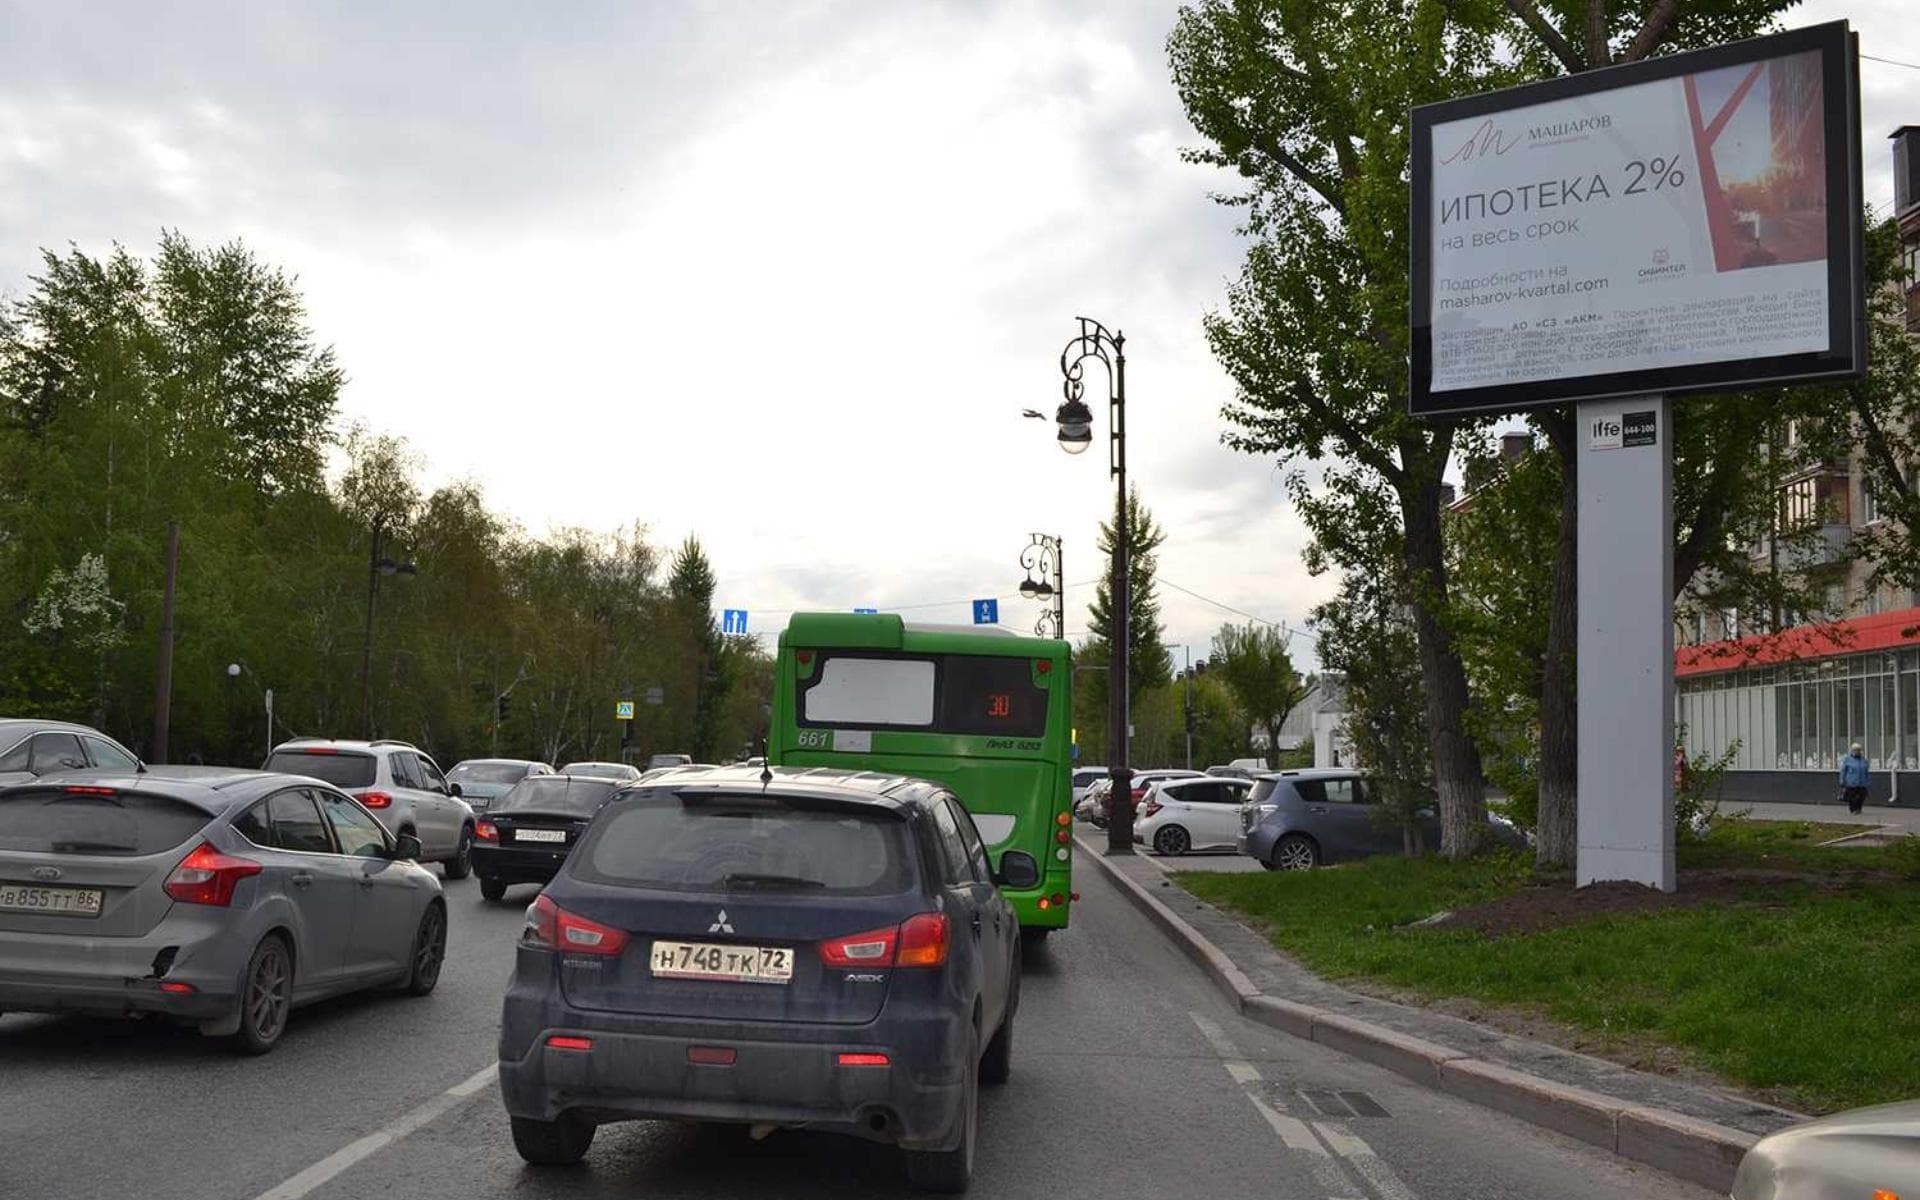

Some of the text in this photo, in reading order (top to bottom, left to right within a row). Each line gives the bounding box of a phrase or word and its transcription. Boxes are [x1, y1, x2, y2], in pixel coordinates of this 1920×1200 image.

[1527, 114, 1612, 141] МАШАРОВ
[1440, 153, 1685, 224] ИПОТЕКА 2%
[1440, 218, 1580, 252] на весь срок
[1440, 264, 1568, 292] Подробности на
[1440, 277, 1609, 309] masharov-kvartal.com
[1511, 321, 1527, 331] АО
[988, 695, 1009, 716] 30
[798, 731, 828, 747] 661
[78, 891, 94, 905] 86
[762, 951, 784, 969] 72
